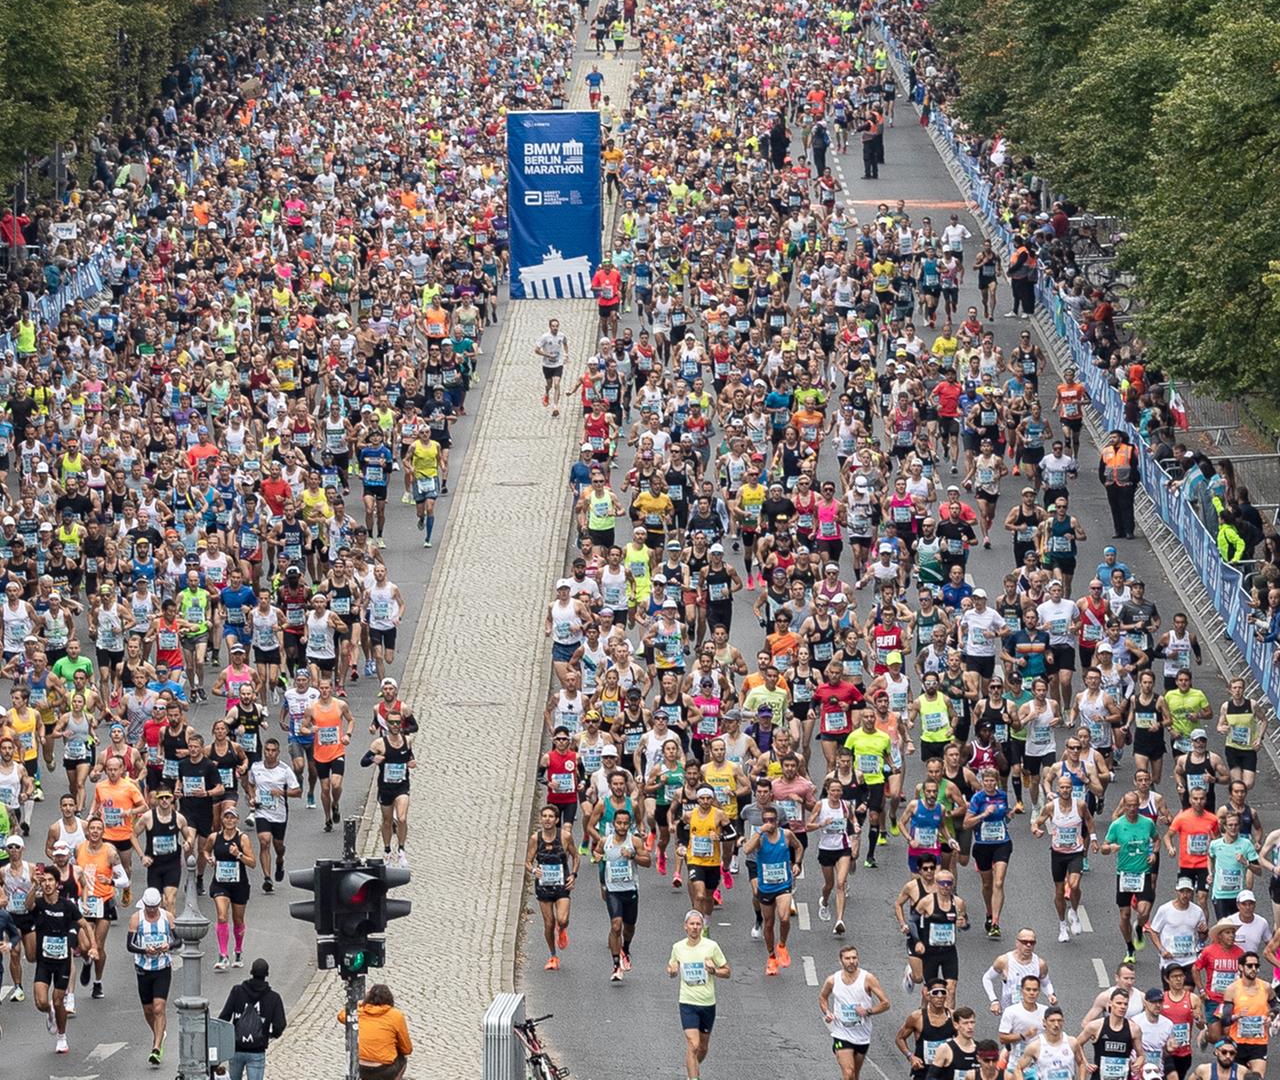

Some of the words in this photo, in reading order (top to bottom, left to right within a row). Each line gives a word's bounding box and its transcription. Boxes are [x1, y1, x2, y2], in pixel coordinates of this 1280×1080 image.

[524, 143, 560, 156] BMW
[524, 155, 561, 165] BERLIN
[524, 165, 584, 175] MARATHON
